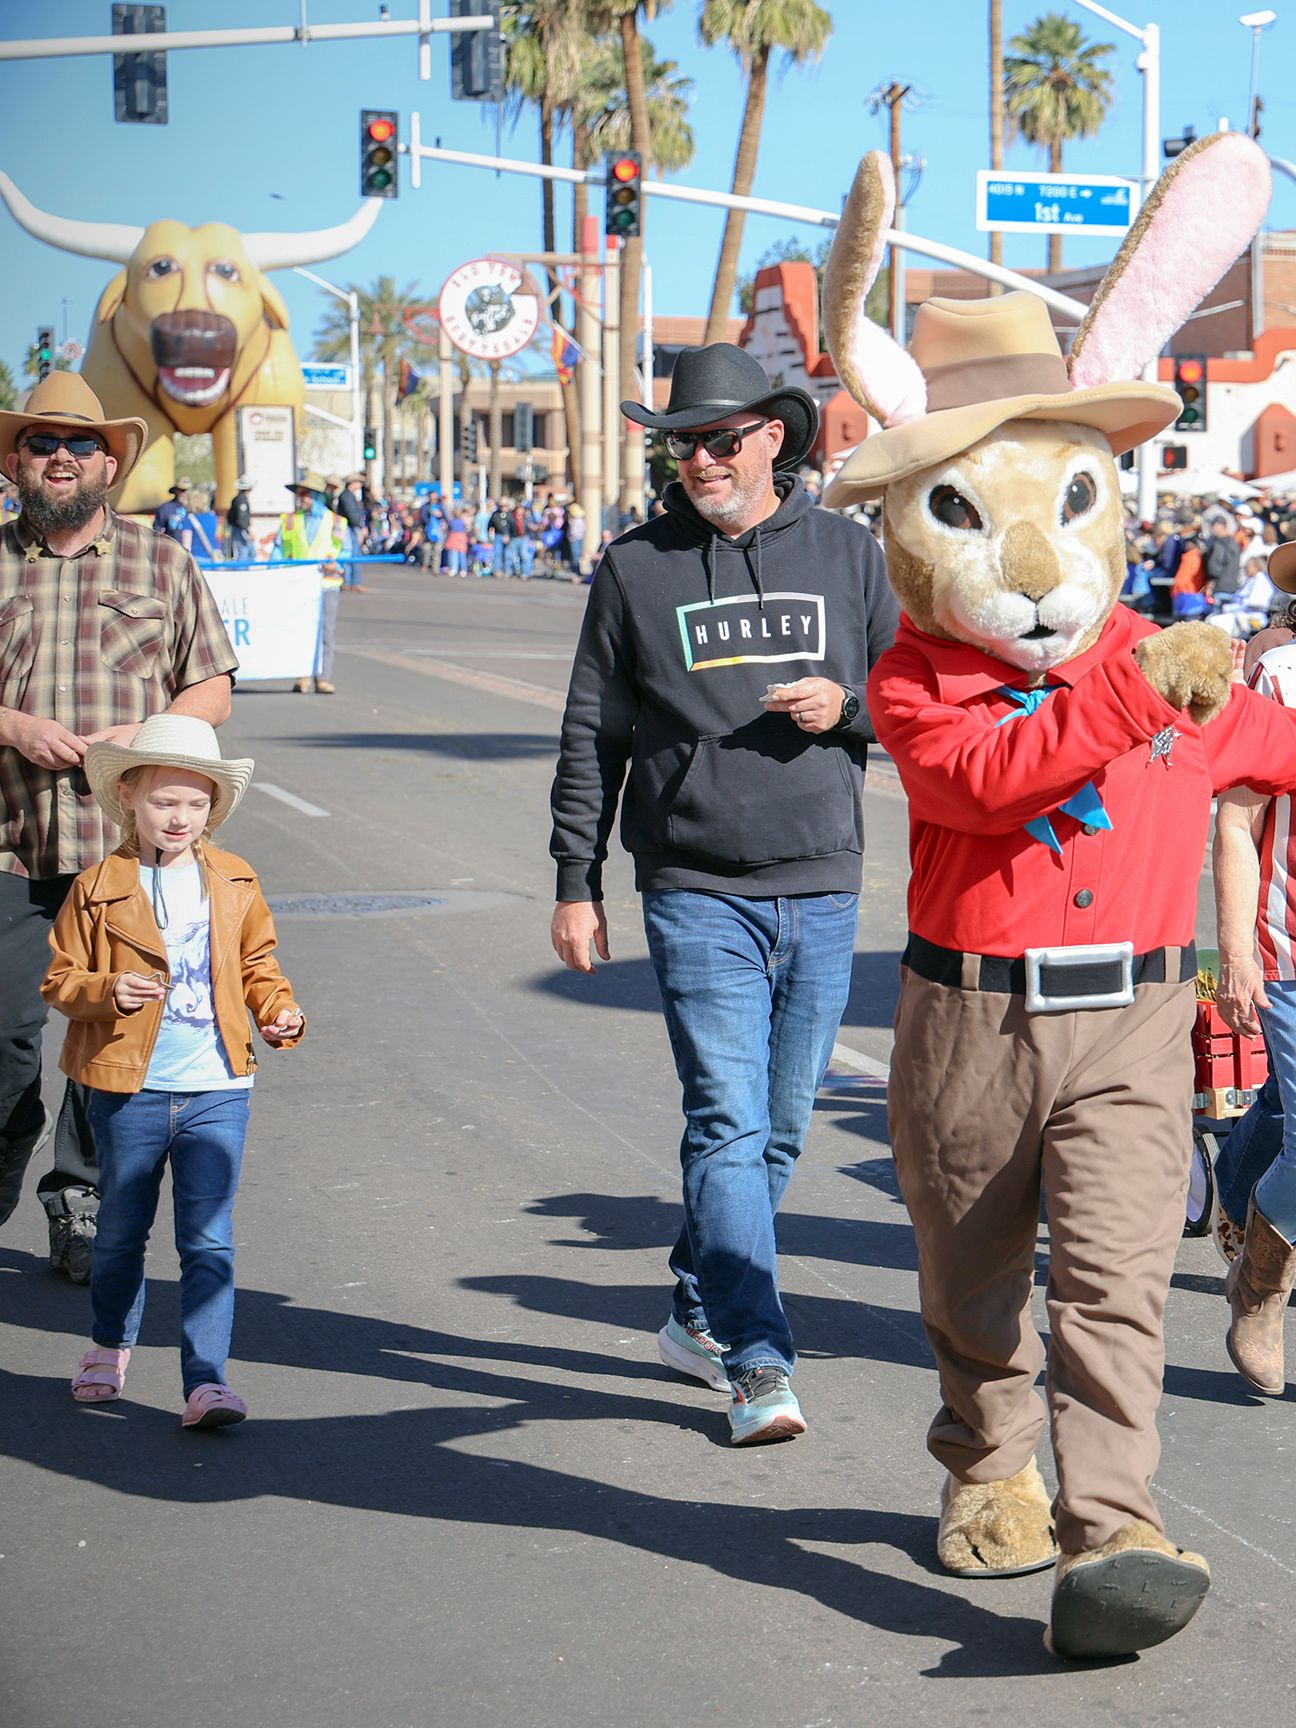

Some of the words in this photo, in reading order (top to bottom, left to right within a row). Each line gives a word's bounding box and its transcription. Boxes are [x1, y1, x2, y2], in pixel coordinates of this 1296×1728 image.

[1034, 202, 1060, 222] 1st
[1063, 212, 1084, 223] Ave
[221, 598, 249, 616] ALE
[695, 615, 811, 644] HURLEY
